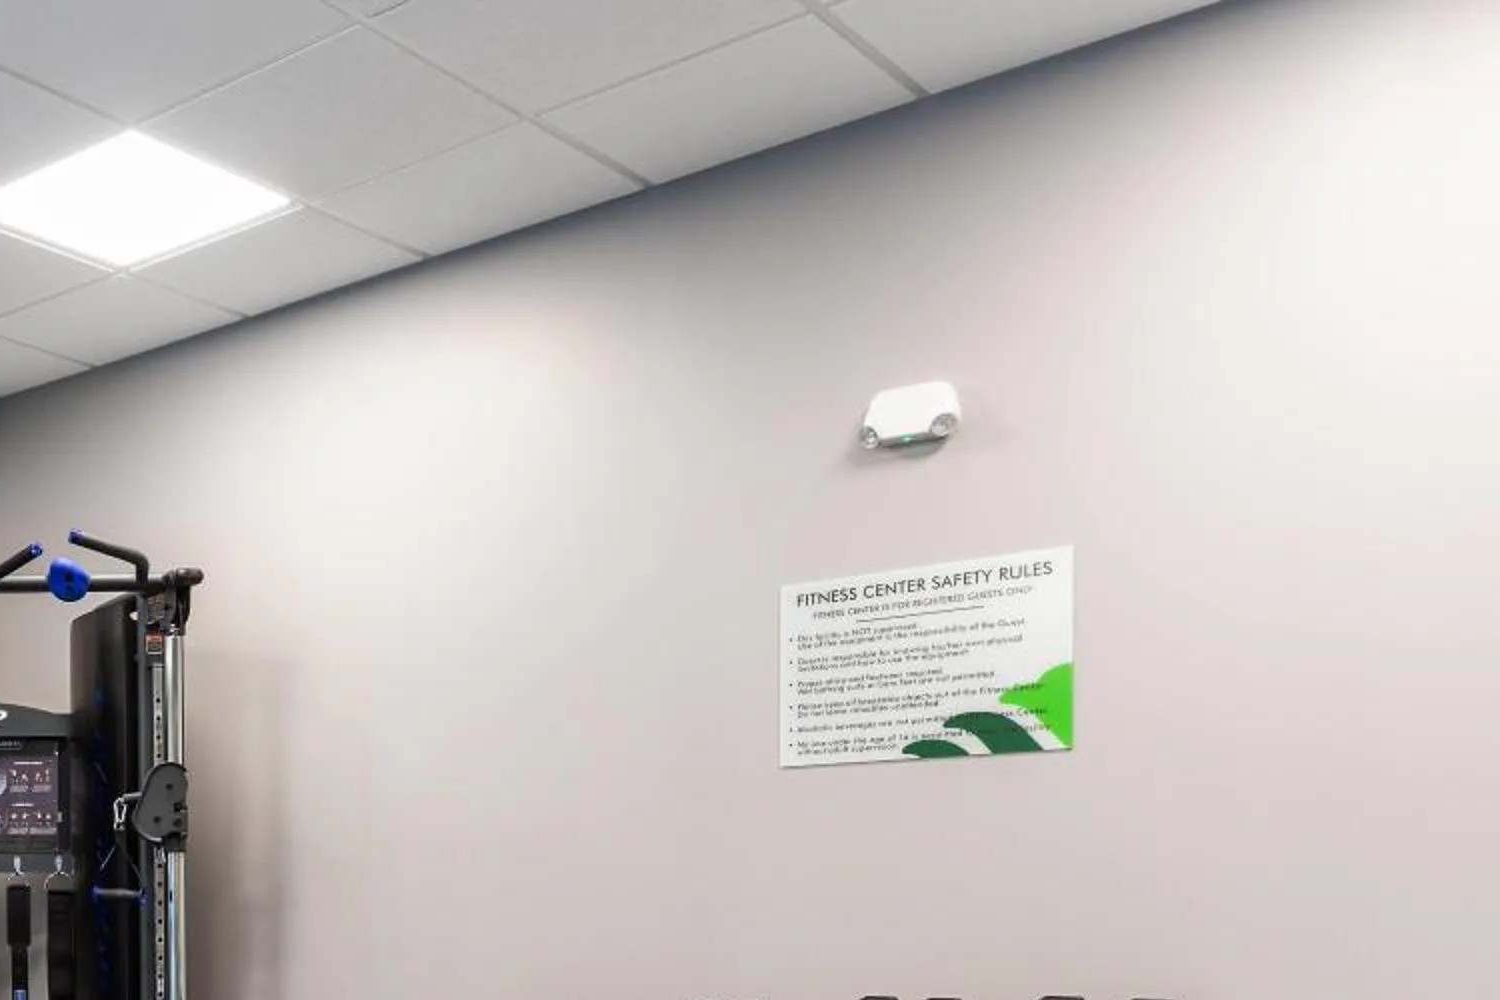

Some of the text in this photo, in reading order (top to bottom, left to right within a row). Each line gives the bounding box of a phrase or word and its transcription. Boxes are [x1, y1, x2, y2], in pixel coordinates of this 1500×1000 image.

[796, 562, 1052, 607] FITNESS CENTER SAFETY RULES
[812, 608, 844, 620] FITNESS
[847, 604, 879, 616] CENTER
[891, 600, 909, 610] FOR
[912, 593, 964, 608] REGISTERED
[967, 588, 1003, 601] GUESTS
